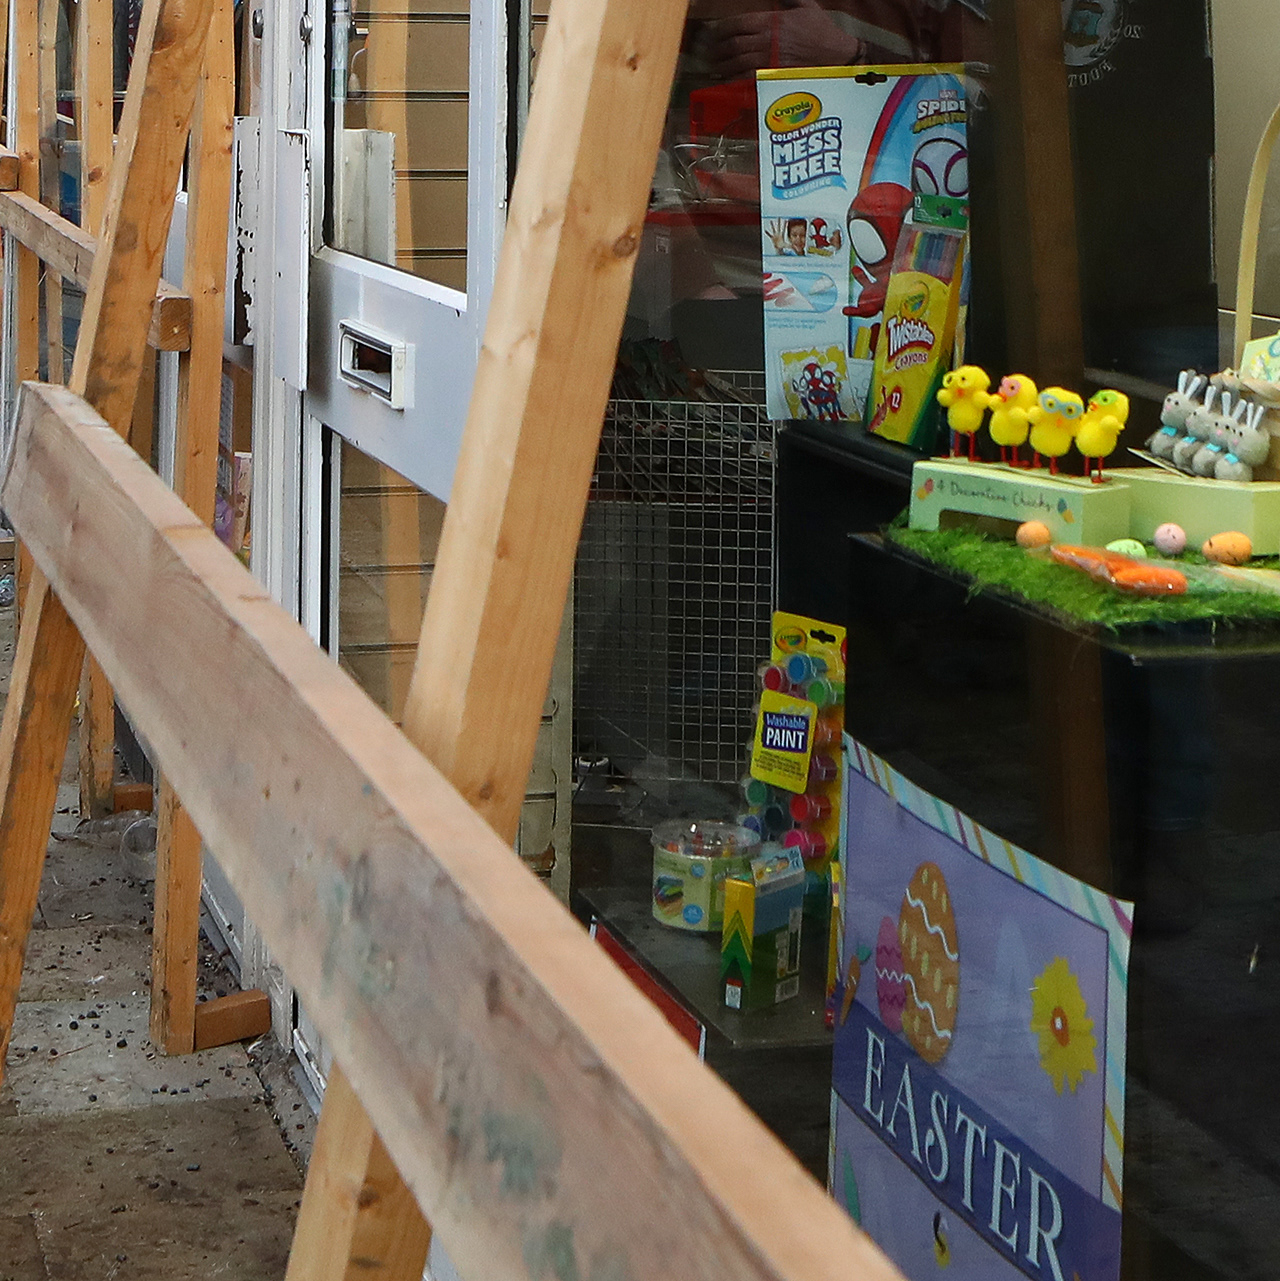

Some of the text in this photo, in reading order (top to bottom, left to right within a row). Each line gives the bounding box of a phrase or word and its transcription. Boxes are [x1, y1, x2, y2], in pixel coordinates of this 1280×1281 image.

[774, 100, 811, 117] Crayola
[771, 118, 840, 142] COLOR WONDER
[773, 129, 840, 165] MESS
[775, 151, 841, 187] FREE
[895, 352, 928, 371] Crayons
[766, 713, 806, 730] Washable
[765, 727, 805, 750] PAINT
[863, 1026, 1067, 1281] EASTER
